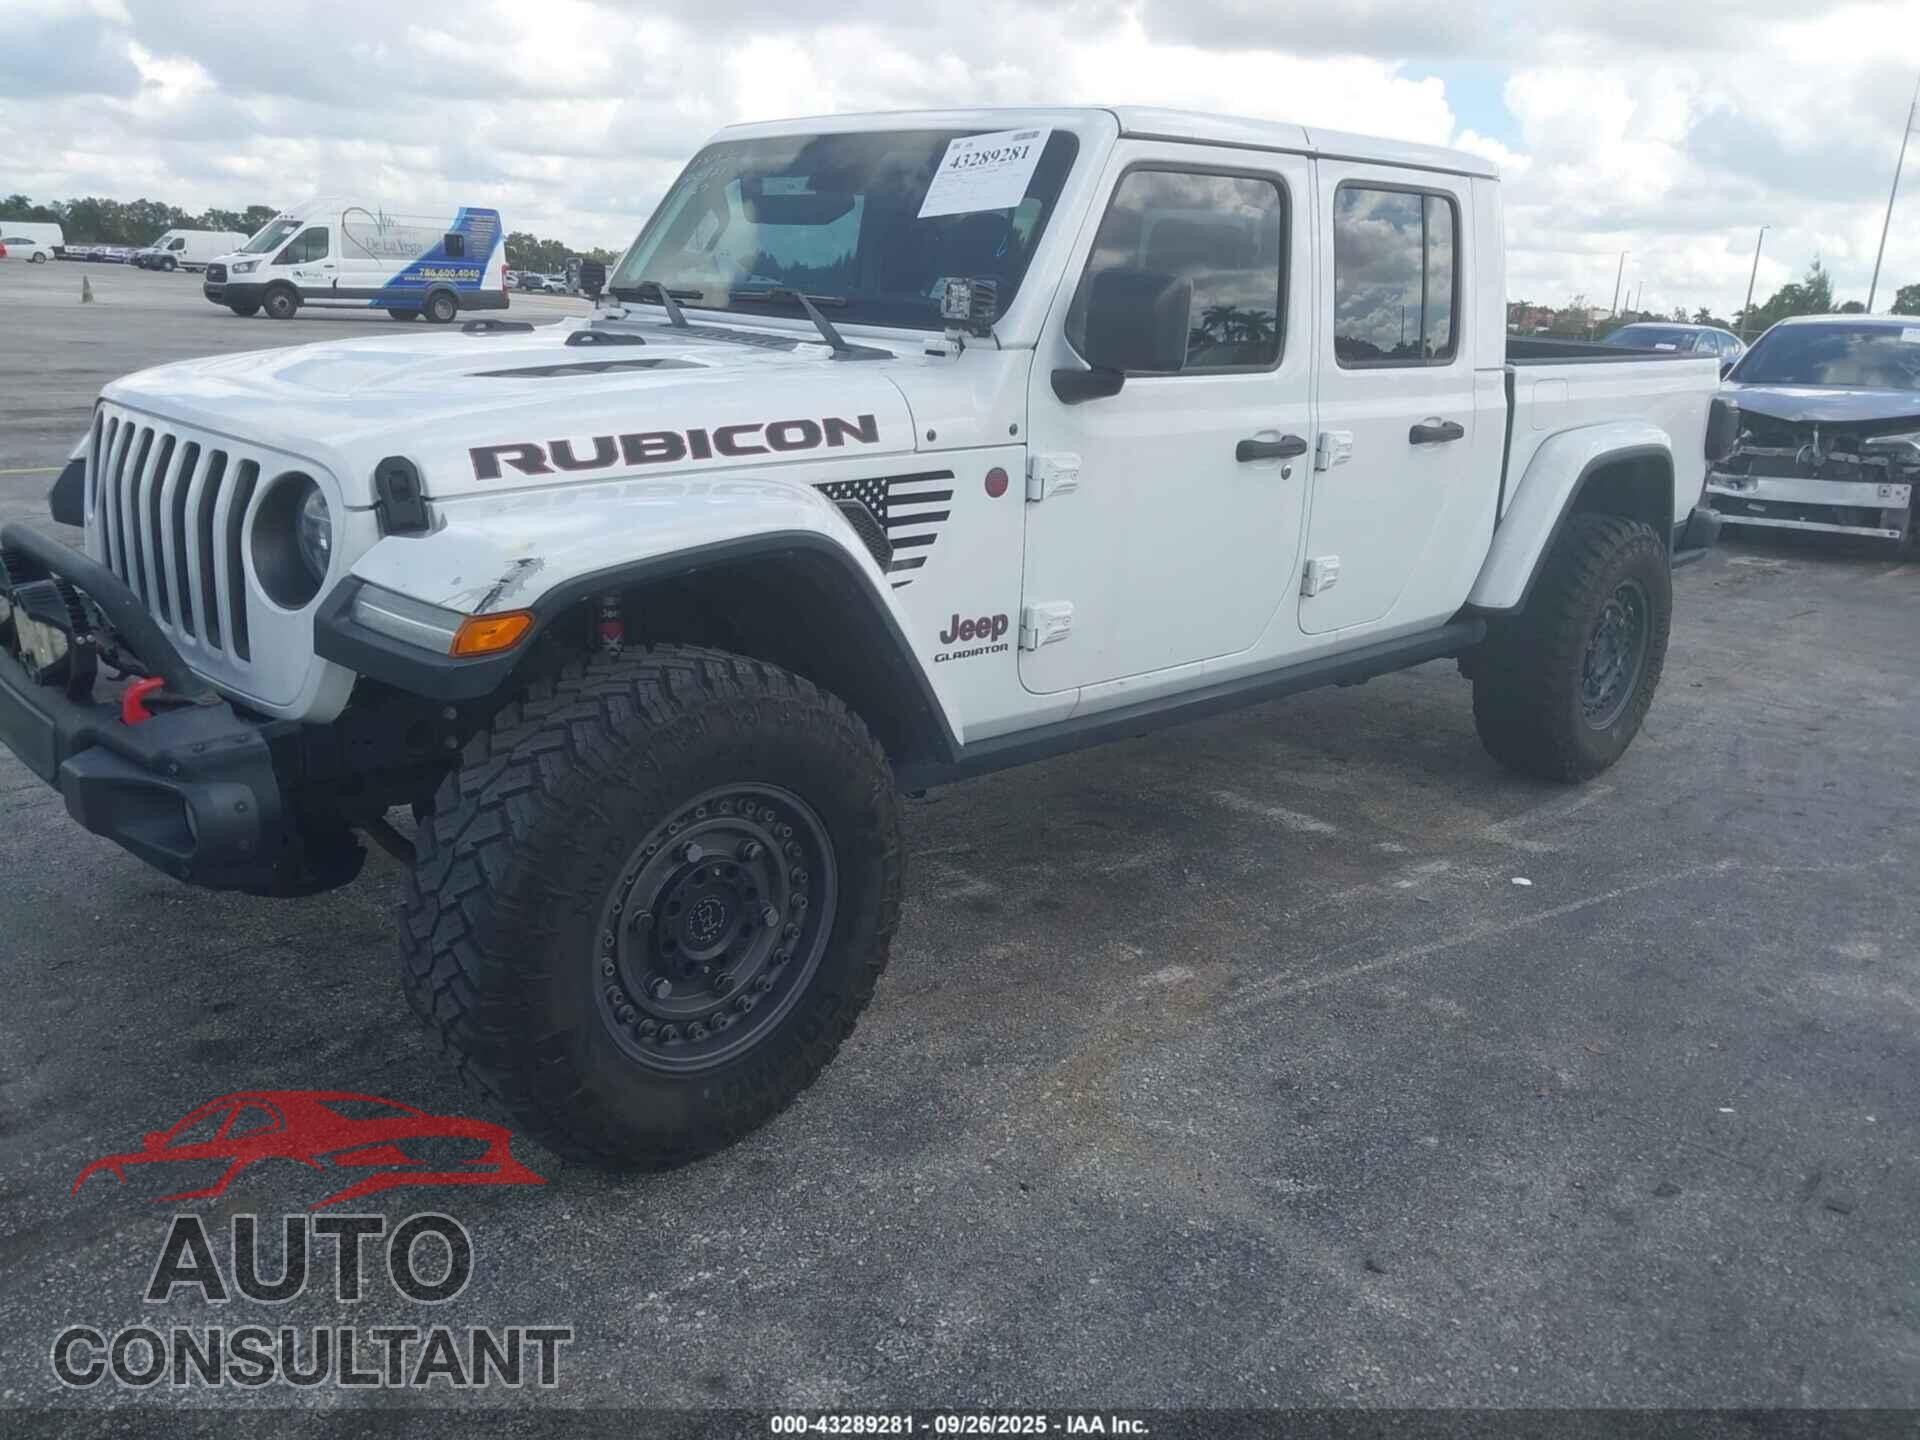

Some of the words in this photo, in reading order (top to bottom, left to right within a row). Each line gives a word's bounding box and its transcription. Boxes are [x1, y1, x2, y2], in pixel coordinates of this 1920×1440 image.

[949, 145, 1031, 169] 43289281
[469, 413, 880, 481] RUBICON
[940, 613, 1009, 645] Jeep
[934, 643, 1009, 663] GLADIATOR
